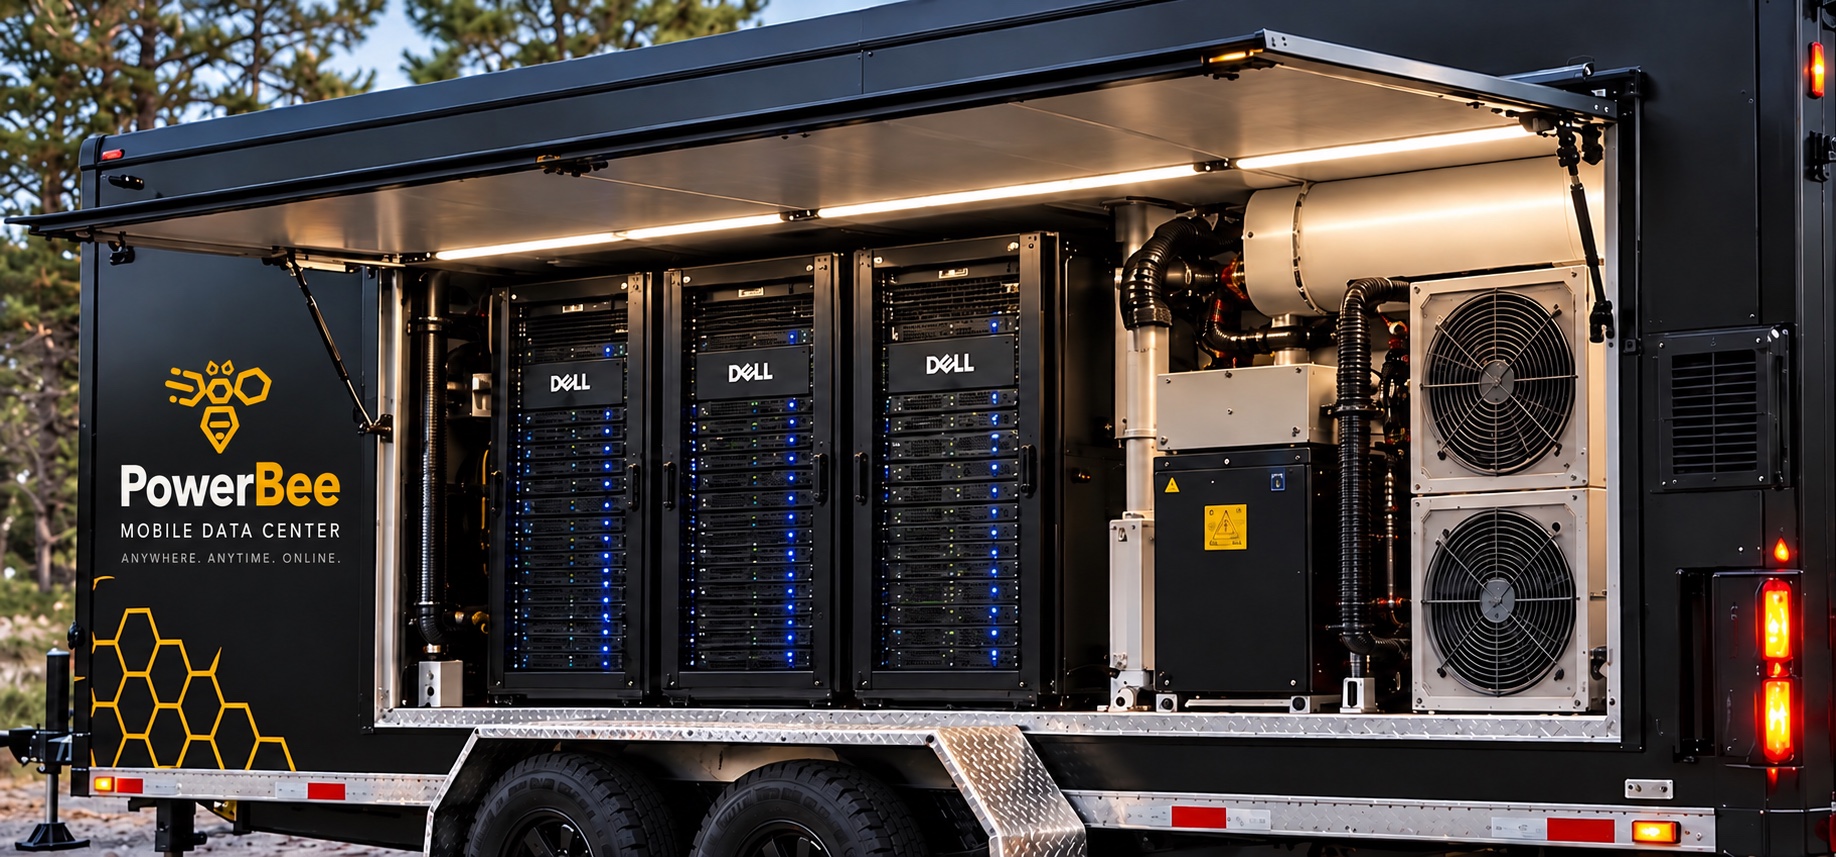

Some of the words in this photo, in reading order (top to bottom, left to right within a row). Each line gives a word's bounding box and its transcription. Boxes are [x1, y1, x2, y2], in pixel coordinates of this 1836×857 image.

[729, 363, 773, 382] DELL
[927, 354, 974, 374] DELL
[551, 374, 590, 392] DELL
[120, 461, 340, 507] PowerBee
[121, 522, 192, 538] MOBILE
[202, 522, 252, 538] DATA
[262, 522, 340, 538] CENTER
[121, 553, 201, 563] ANYWHERE.
[208, 553, 275, 563] ANYTIME.
[282, 553, 341, 563] ONLINE.
